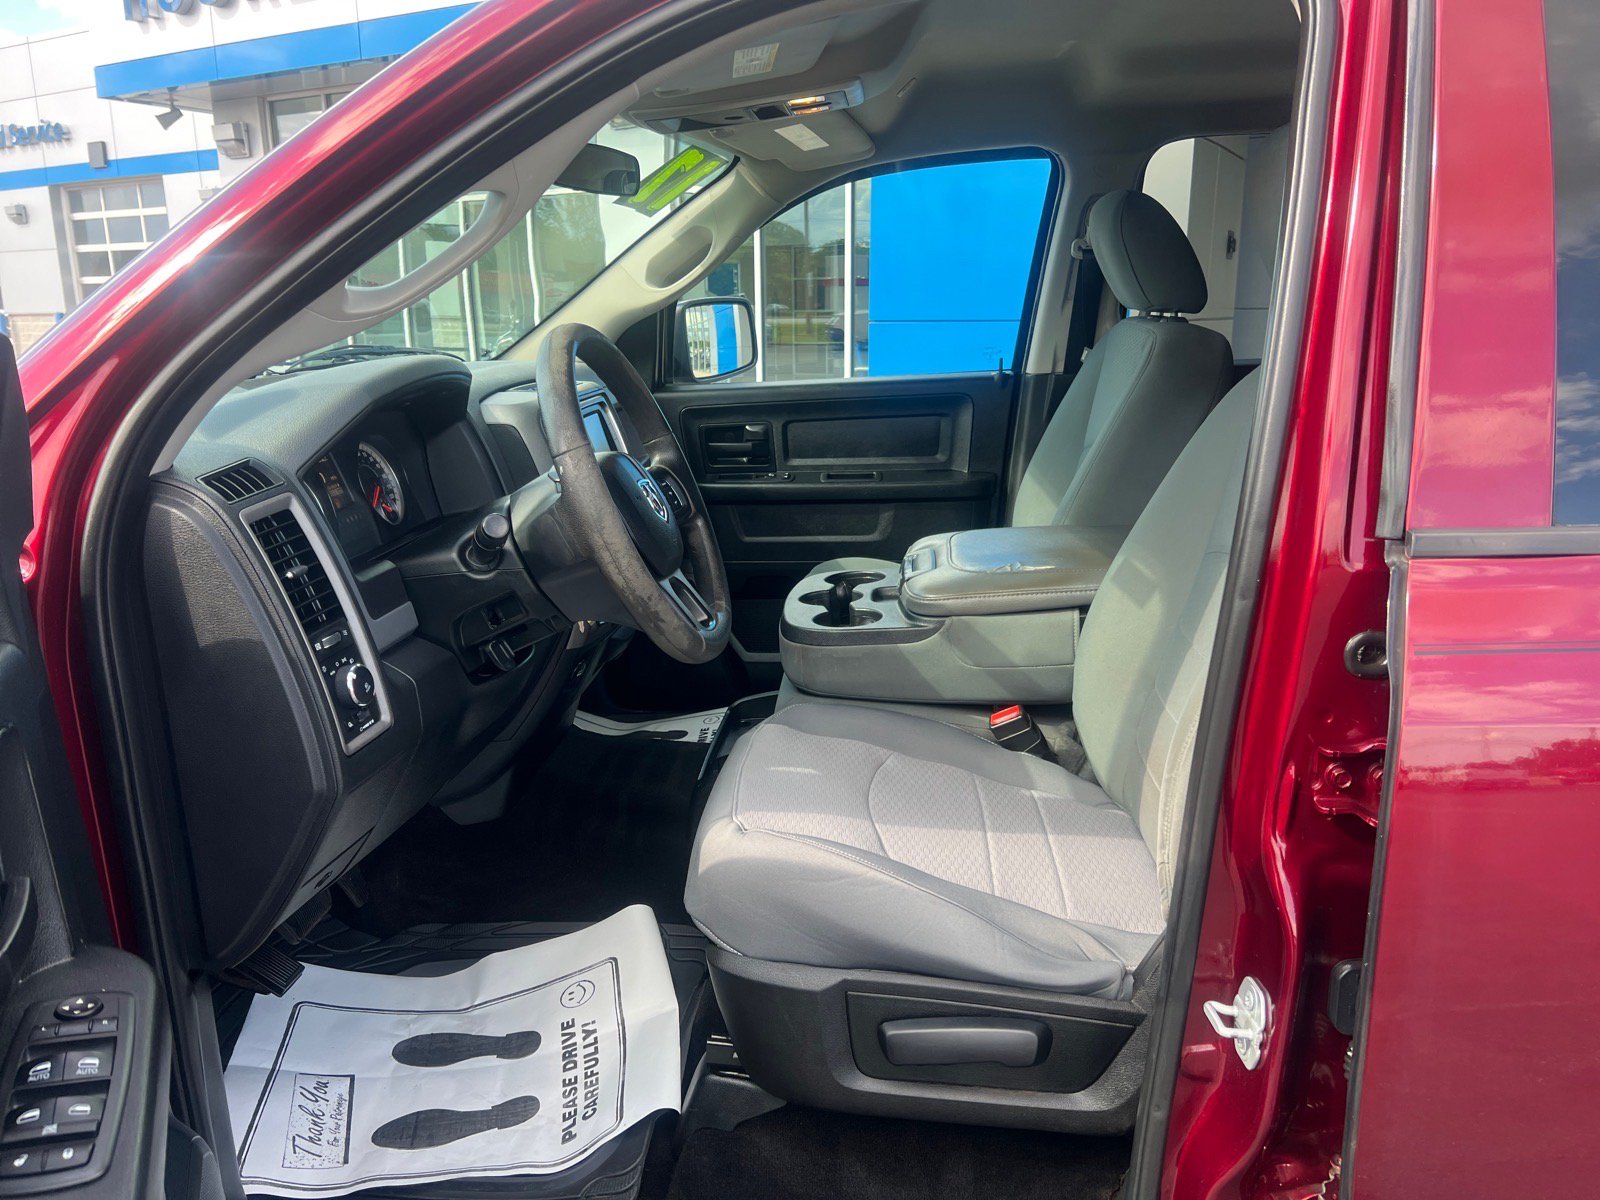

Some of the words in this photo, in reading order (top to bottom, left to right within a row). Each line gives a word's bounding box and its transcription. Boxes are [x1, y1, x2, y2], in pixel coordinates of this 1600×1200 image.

[75, 1068, 98, 1076] AUTO
[560, 1018, 578, 1073] DRIVE
[581, 1019, 600, 1121] CAREFULLY!
[27, 1072, 50, 1083] AUTO
[299, 1080, 329, 1102] You
[292, 1104, 326, 1158] Thank
[561, 1075, 578, 1145] PLEASE
